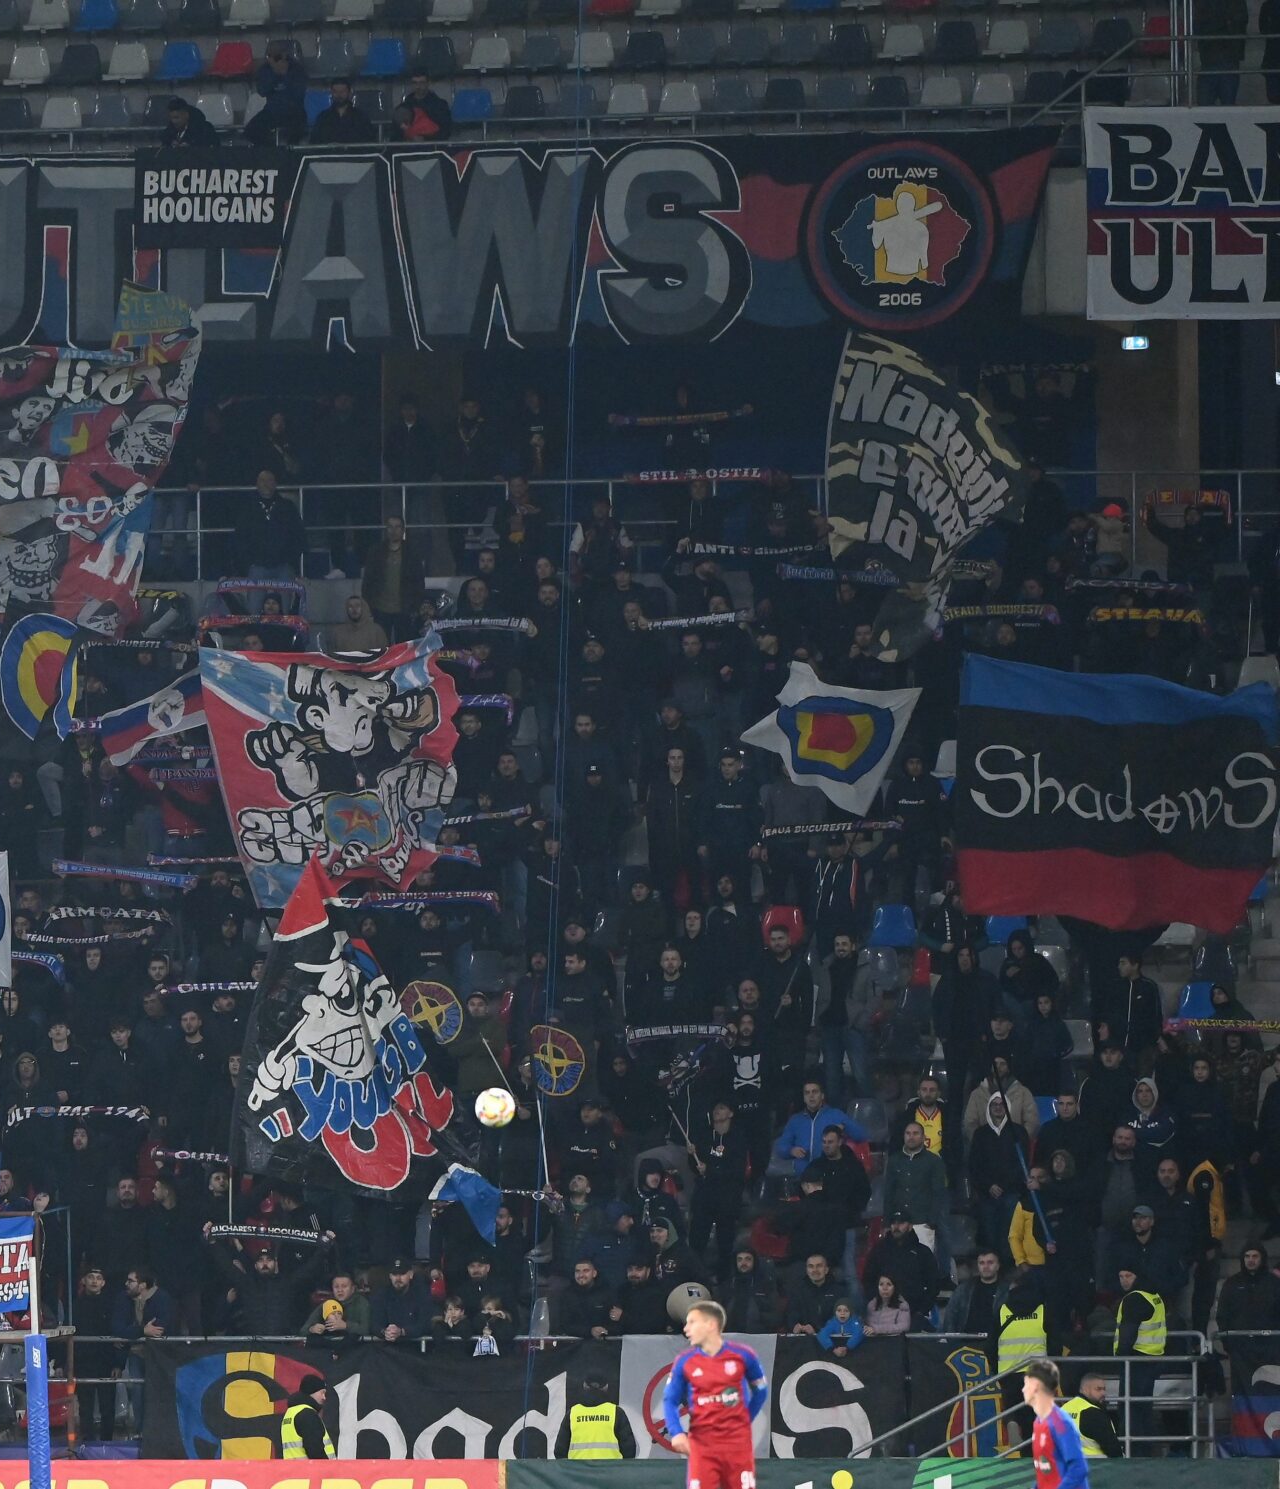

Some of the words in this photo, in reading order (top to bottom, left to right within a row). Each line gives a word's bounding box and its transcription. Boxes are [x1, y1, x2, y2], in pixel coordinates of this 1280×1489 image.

[867, 166, 938, 180] OUTLAWS
[143, 168, 279, 196] BUCHAREST
[143, 196, 275, 224] HOOLIGANS
[879, 292, 922, 307] 2006
[639, 470, 679, 482] STIL
[705, 467, 762, 480] OSTIL
[694, 543, 735, 556] ANTI
[1094, 607, 1204, 624] STEAUA
[793, 822, 853, 834] BUCURESTI
[56, 933, 110, 945] BUCURESTI
[267, 1226, 319, 1240] HOOLIGANS
[576, 1414, 611, 1424] STEWARD
